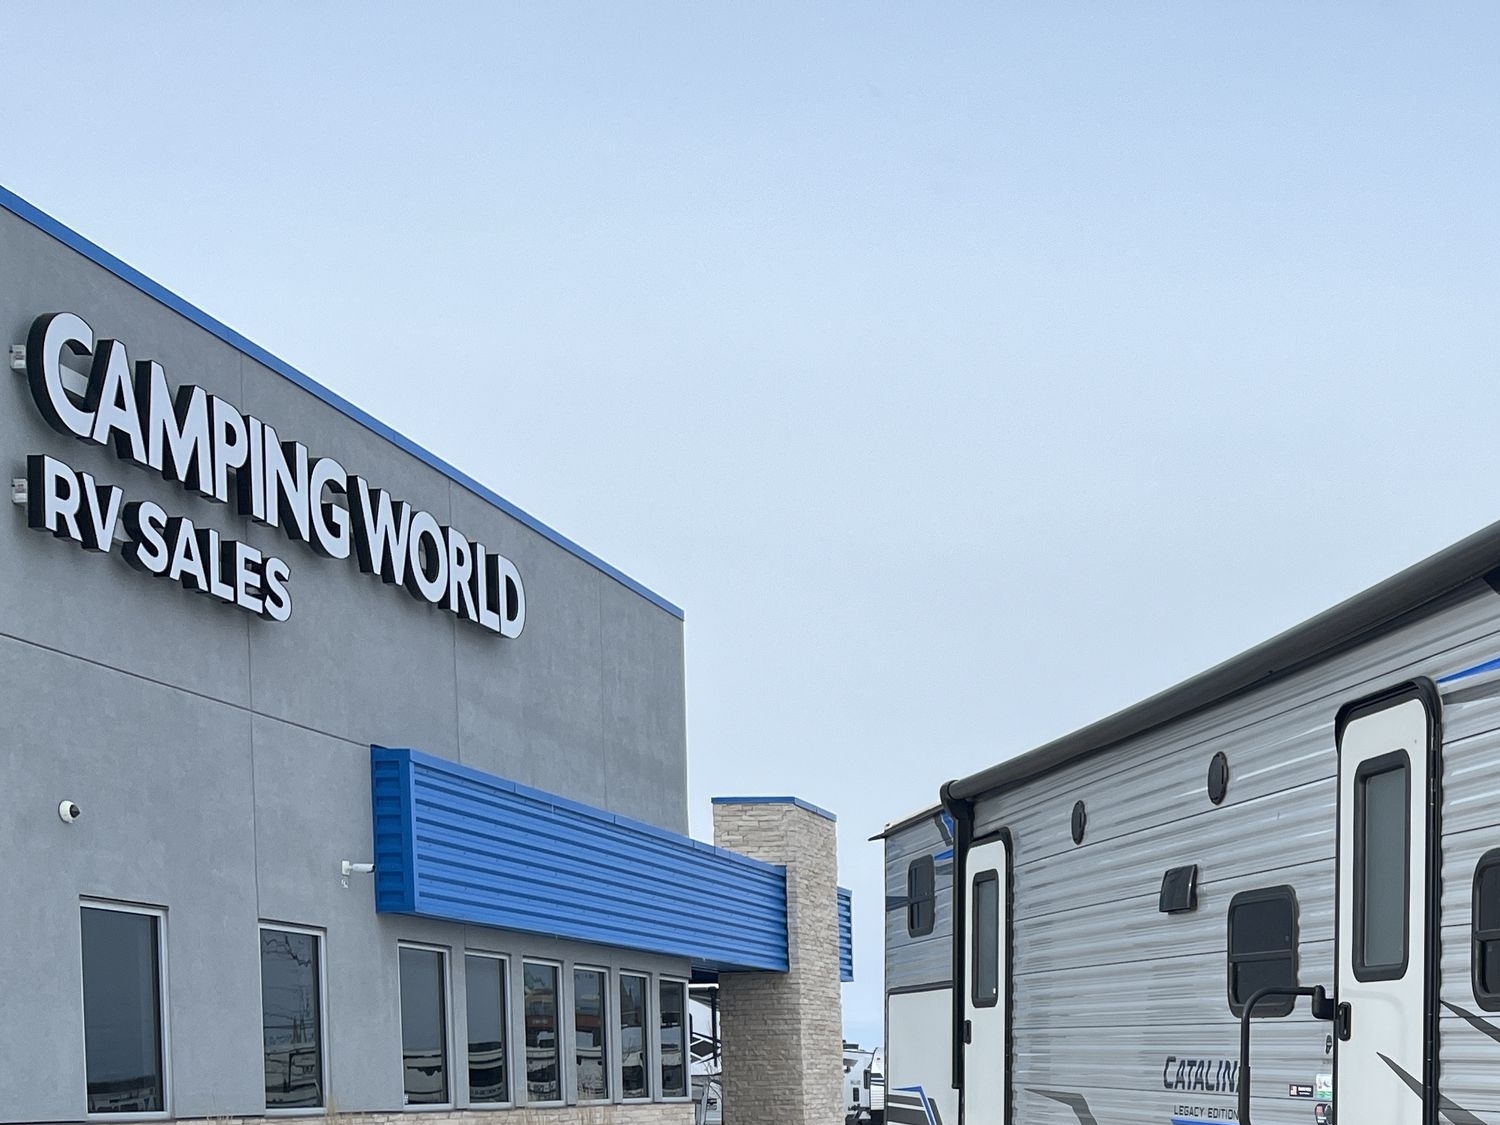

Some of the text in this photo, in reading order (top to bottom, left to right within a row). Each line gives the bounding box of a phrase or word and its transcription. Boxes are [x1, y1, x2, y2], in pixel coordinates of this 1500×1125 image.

[30, 312, 526, 639] CAMPING WORLD
[28, 453, 292, 622] RV SALES
[1163, 1055, 1240, 1093] CATALIN
[1174, 1104, 1205, 1117] LEGACY
